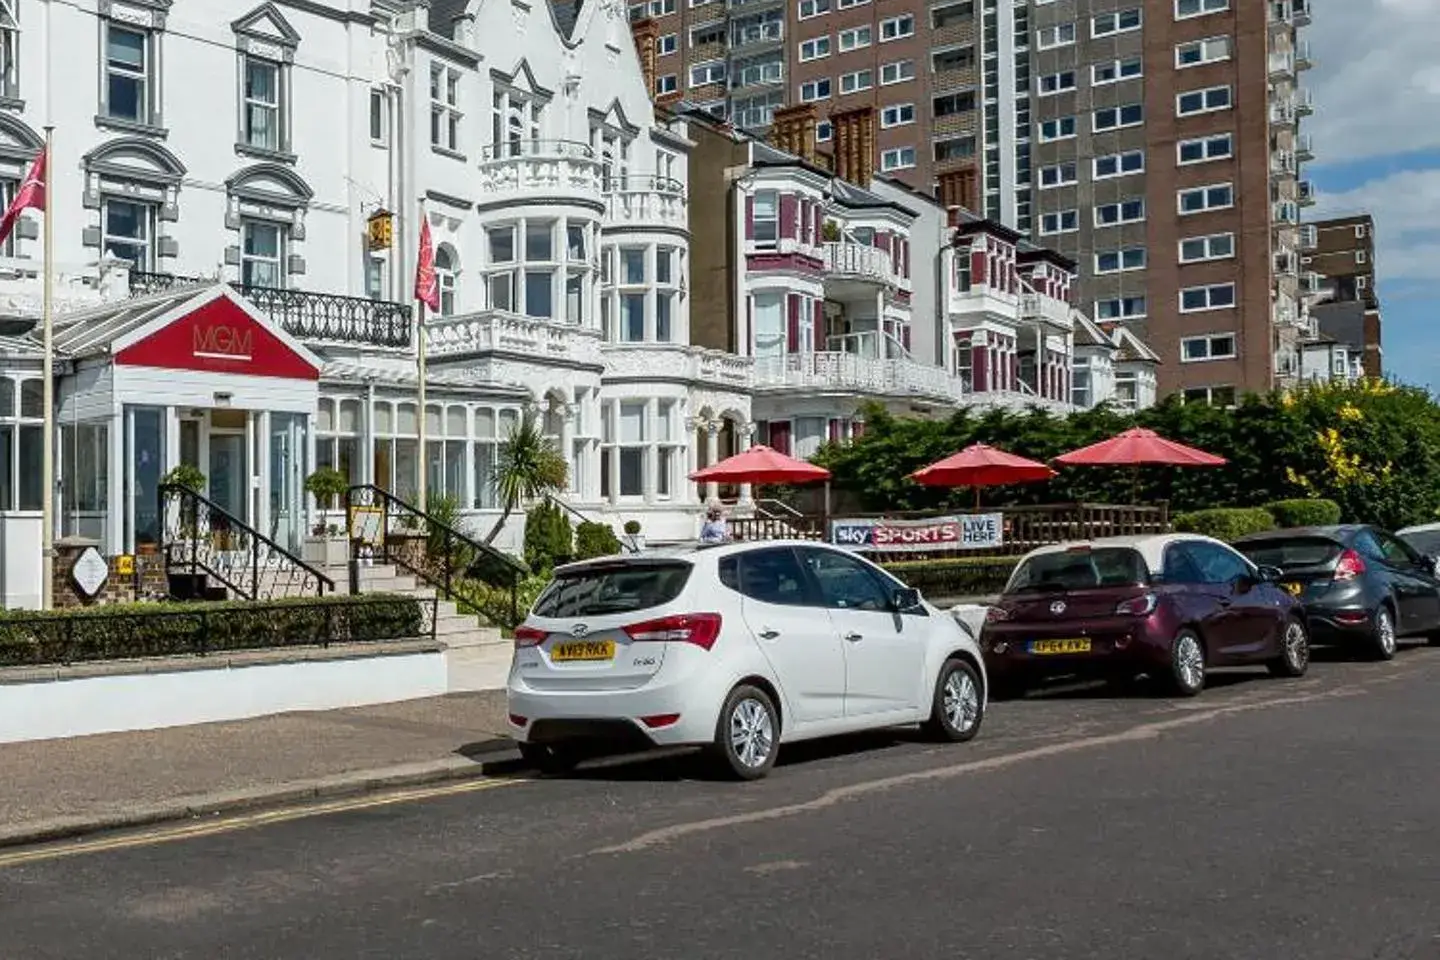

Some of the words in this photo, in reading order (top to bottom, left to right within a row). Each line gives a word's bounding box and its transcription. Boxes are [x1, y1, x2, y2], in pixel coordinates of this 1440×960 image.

[193, 324, 252, 353] MGM
[963, 520, 995, 531] LIVE
[838, 526, 868, 544] sky
[876, 524, 956, 543] SPORTS
[963, 531, 996, 542] HERE
